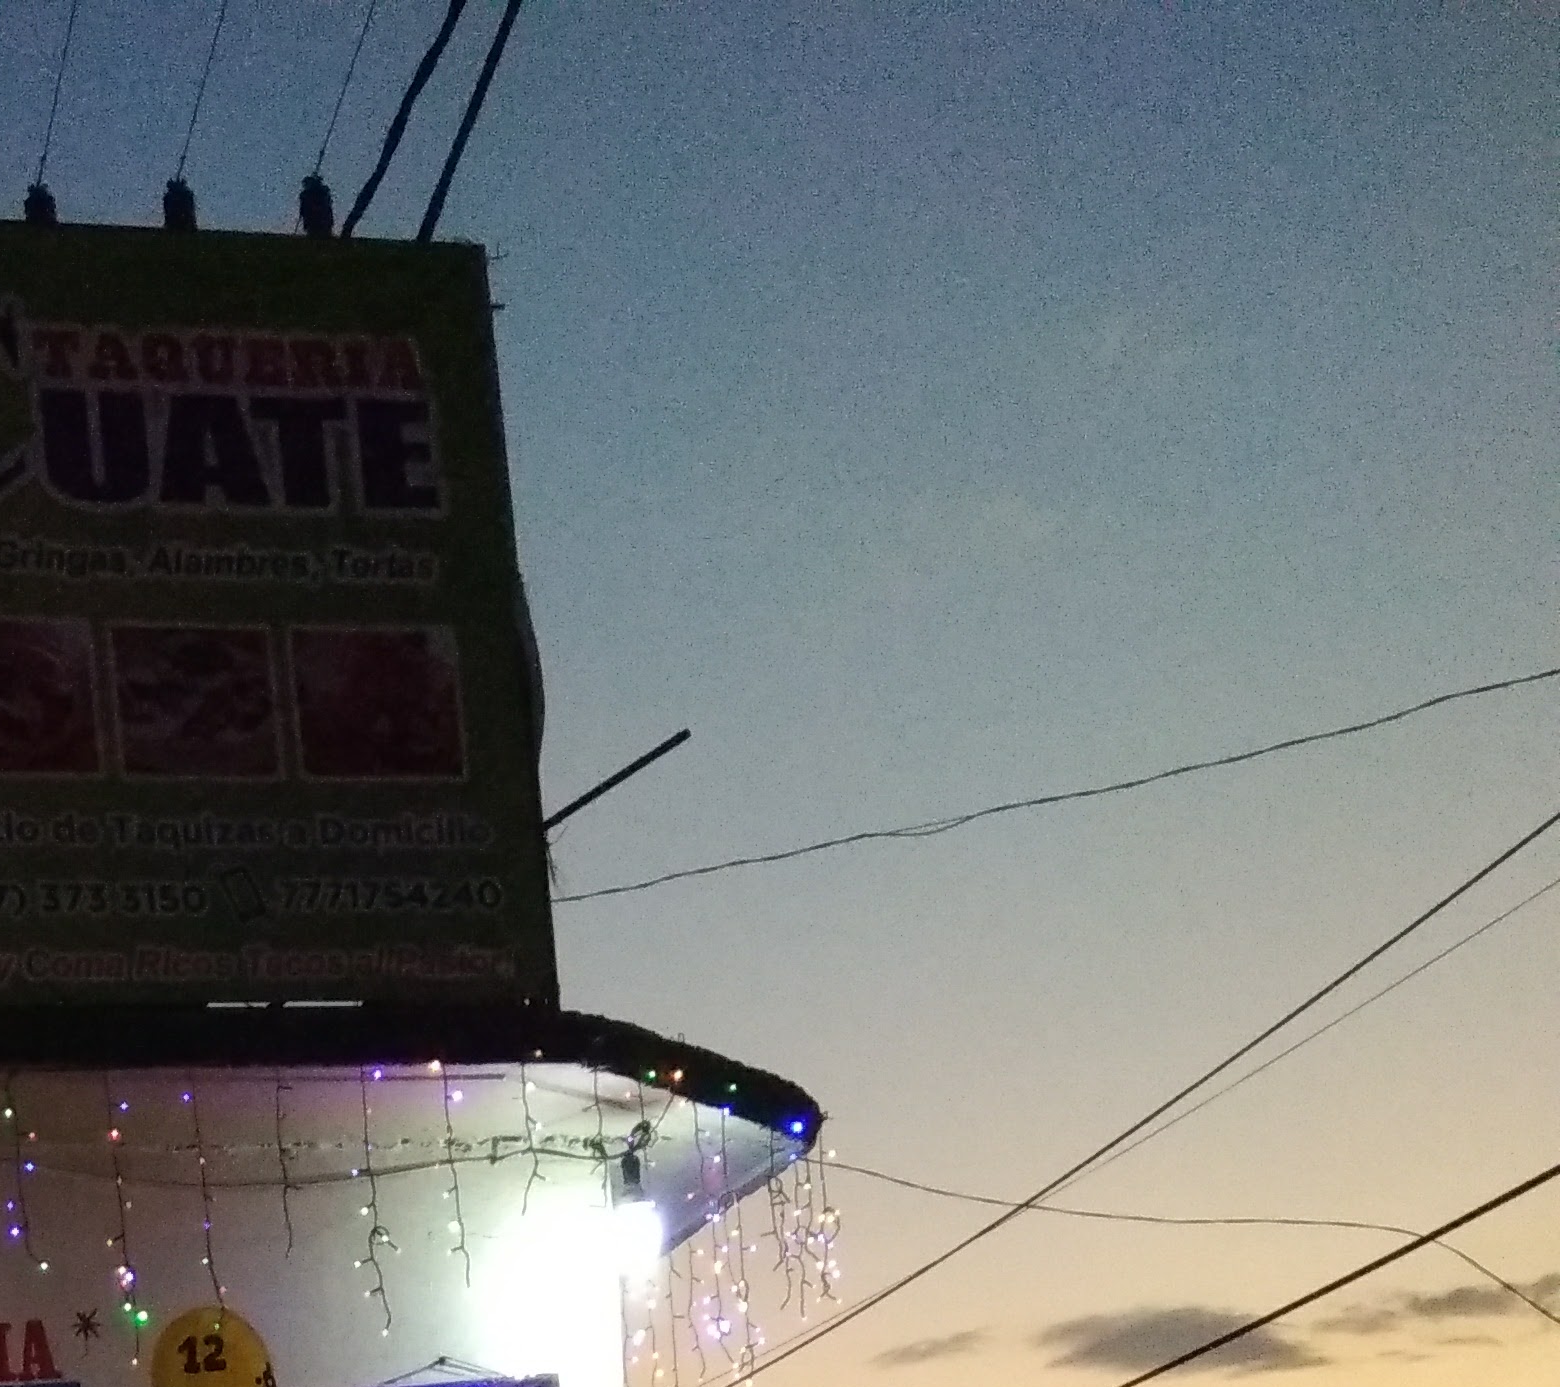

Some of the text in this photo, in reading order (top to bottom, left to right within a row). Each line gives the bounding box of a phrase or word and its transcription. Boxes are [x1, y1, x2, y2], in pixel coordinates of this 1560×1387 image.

[33, 329, 421, 391] TAQUERIA
[332, 547, 435, 579] Tortas
[53, 814, 99, 843] de
[109, 816, 275, 849] Taquizas
[288, 824, 309, 845] a
[319, 816, 487, 845] Domicilio
[40, 883, 107, 913] 373
[120, 884, 207, 914] 3150
[177, 1334, 228, 1374] 12
